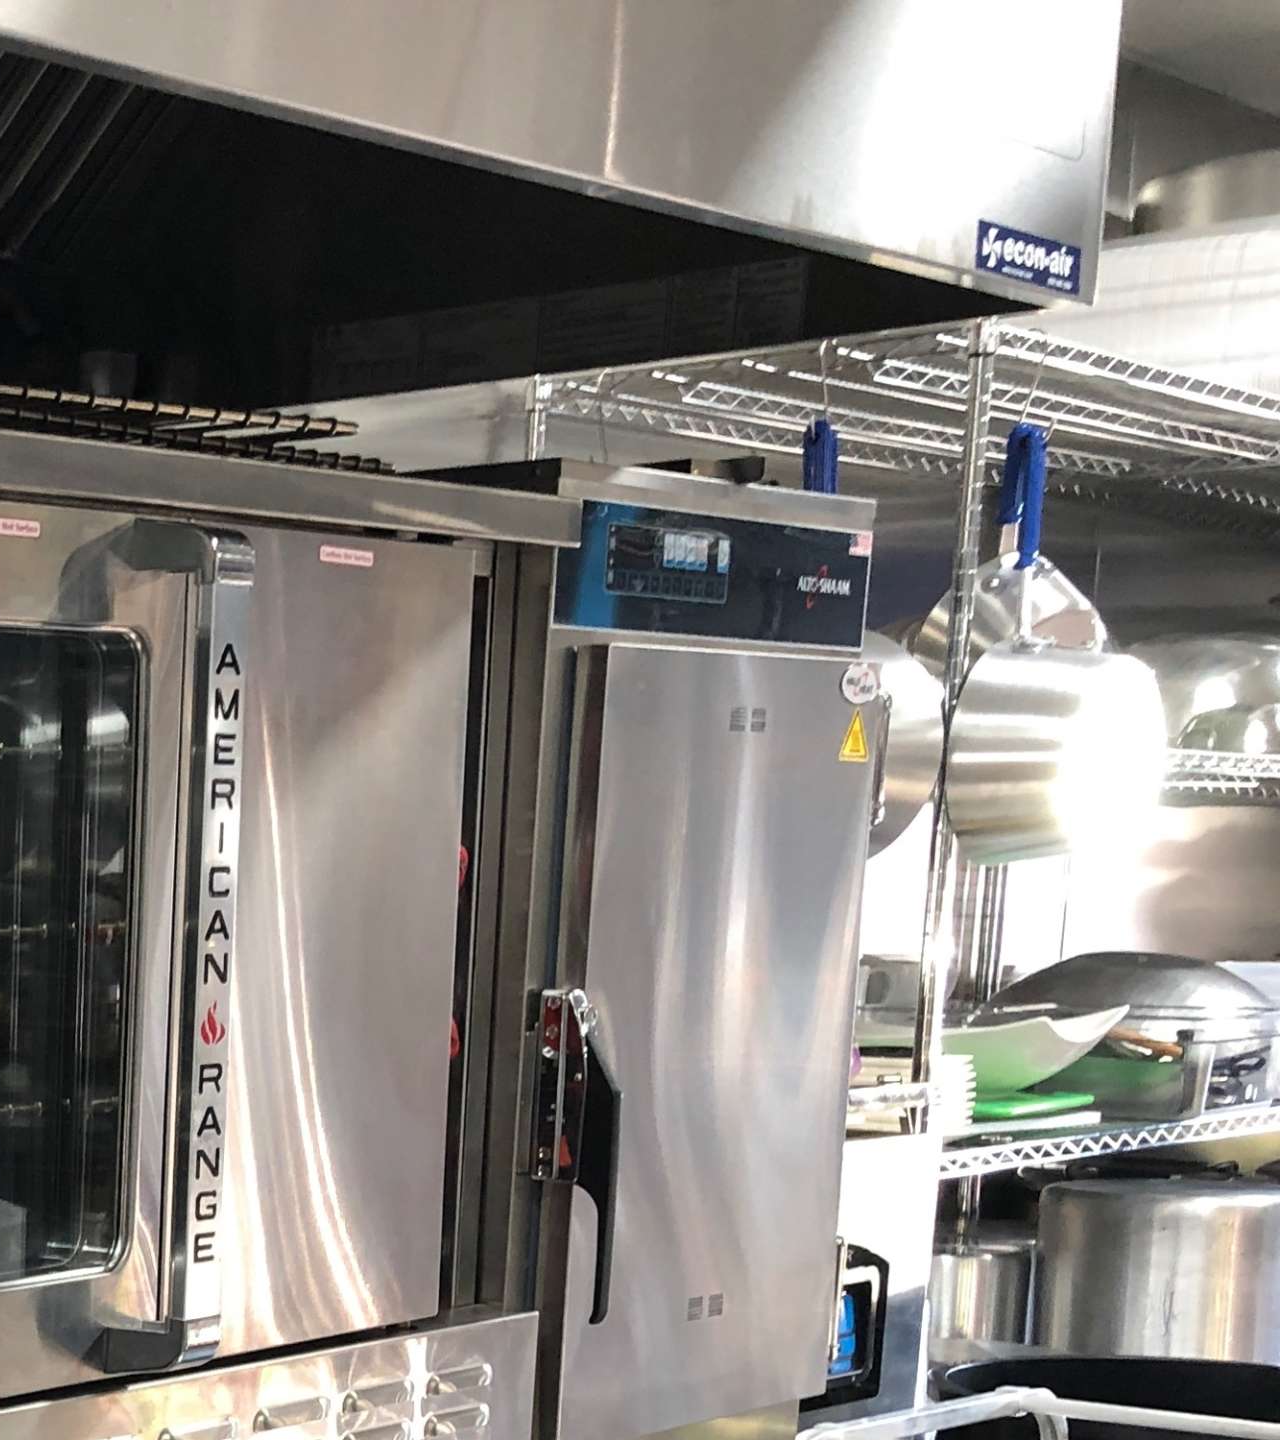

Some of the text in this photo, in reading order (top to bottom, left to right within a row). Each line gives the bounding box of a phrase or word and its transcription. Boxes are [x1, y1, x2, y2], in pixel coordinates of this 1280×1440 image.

[1003, 238, 1074, 277] econ-air
[193, 643, 241, 1264] AMERICAN RANGE
